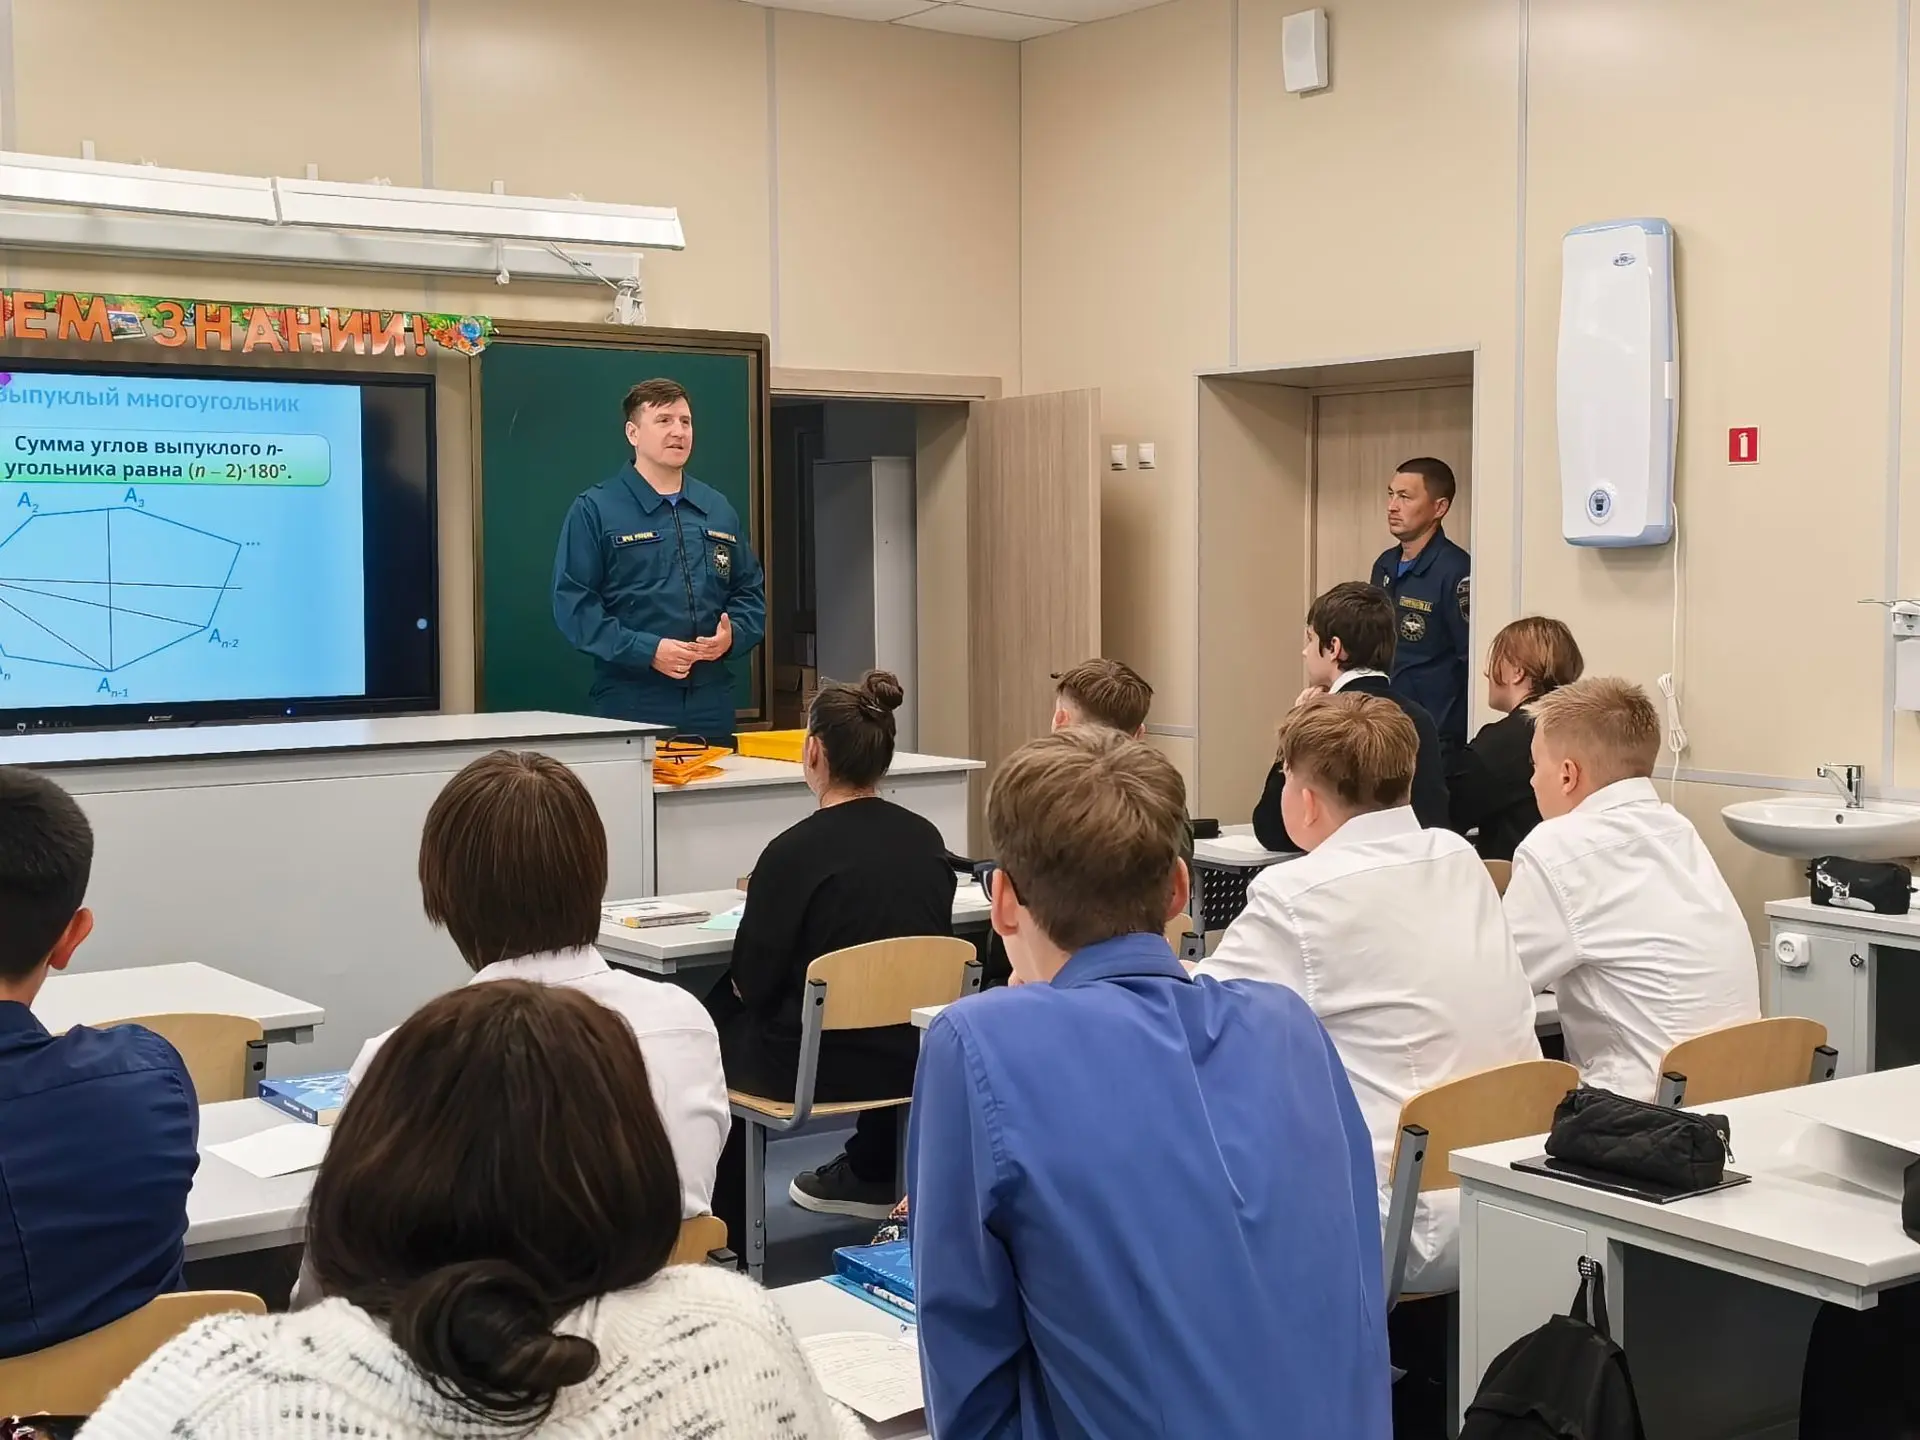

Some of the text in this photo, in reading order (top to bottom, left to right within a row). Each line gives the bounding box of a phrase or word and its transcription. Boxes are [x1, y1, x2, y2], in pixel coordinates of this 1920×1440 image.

[0, 290, 113, 343] ЕМ
[127, 392, 300, 412] многоугольник
[14, 435, 85, 456] Сумма
[90, 439, 149, 457] углов
[154, 441, 261, 459] выпуклого
[4, 462, 117, 479] угольника
[123, 464, 183, 481] равна
